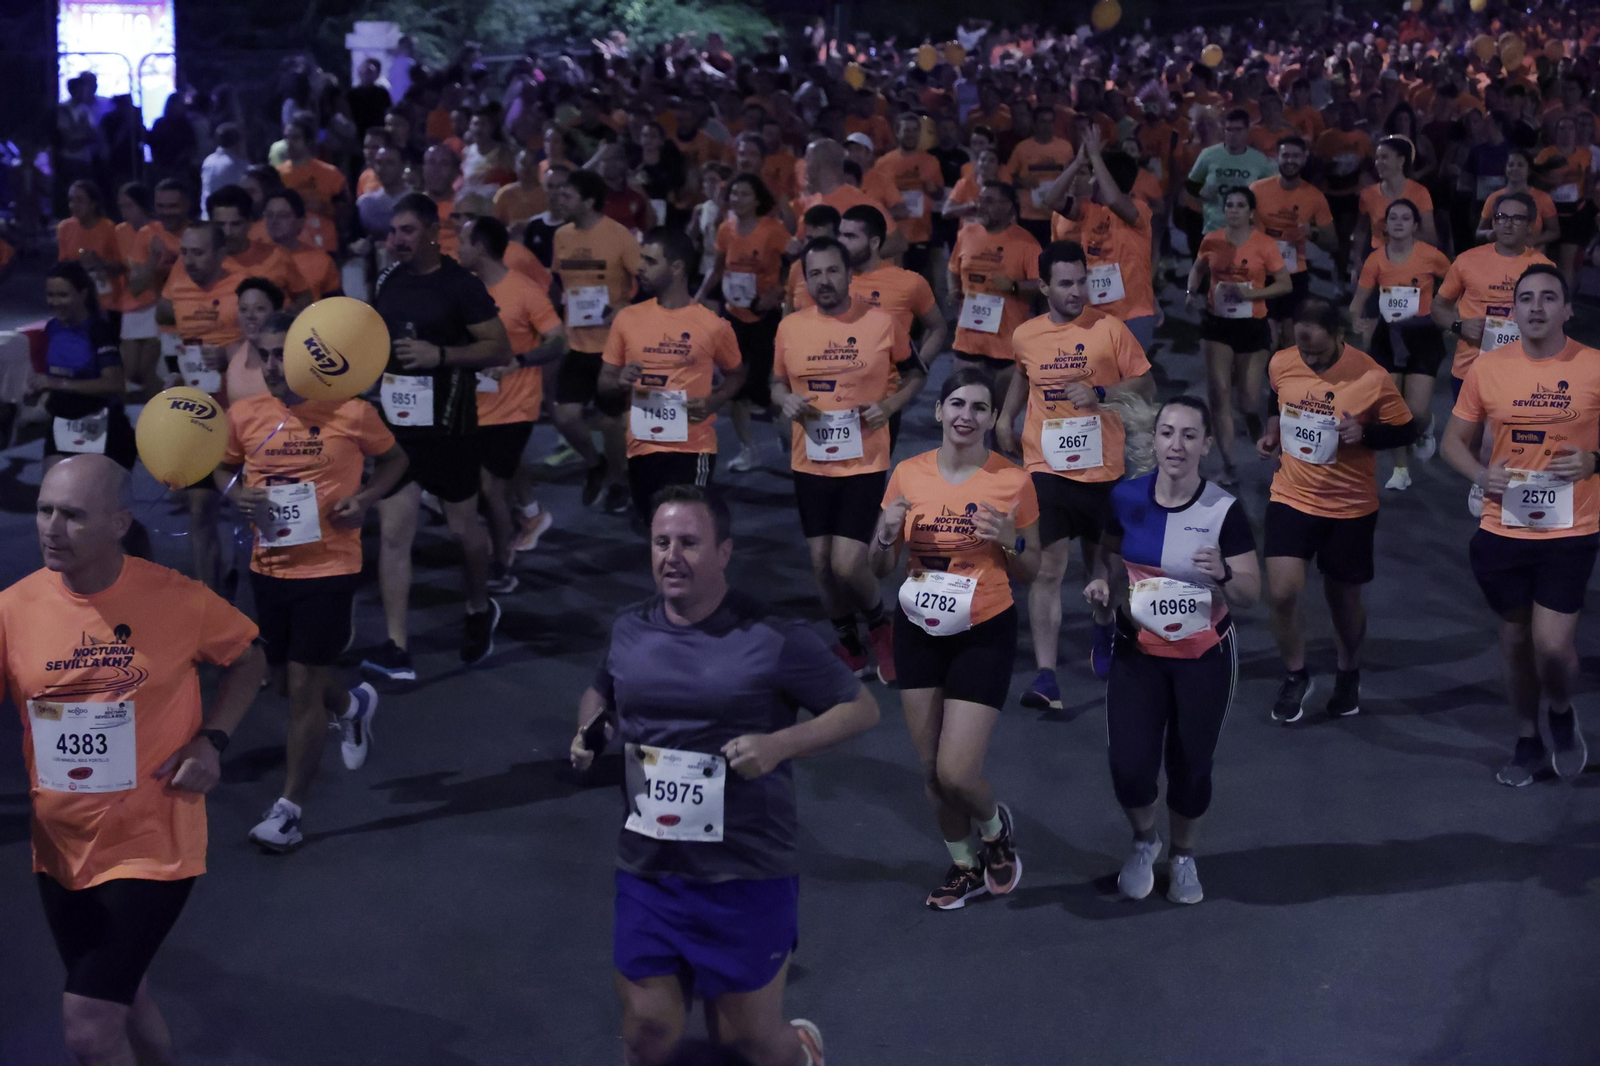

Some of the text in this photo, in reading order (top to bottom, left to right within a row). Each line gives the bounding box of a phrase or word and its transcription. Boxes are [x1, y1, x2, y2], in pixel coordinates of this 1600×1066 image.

[1216, 168, 1250, 178] sano
[1091, 277, 1112, 288] 7739
[1388, 298, 1408, 308] 8962
[392, 392, 416, 405] 6851
[1530, 393, 1572, 401] NOCTURNA
[1300, 400, 1335, 412] NOCTURNA
[643, 407, 676, 420] 11489
[816, 427, 850, 440] 10779
[1295, 426, 1322, 444] 2661
[1516, 432, 1540, 442] Sevilla
[282, 440, 324, 448] NOCTURNA
[1058, 435, 1088, 449] 2667
[1522, 490, 1556, 504] 2570
[934, 516, 975, 526] NOCTURN
[915, 524, 952, 534] SEVILLA
[915, 591, 956, 613] 12782
[1150, 598, 1196, 616] 16968
[72, 646, 135, 658] NOCTURNA
[45, 658, 100, 671] SEVILLA
[56, 733, 108, 754] 4383
[644, 778, 704, 805] 15975
